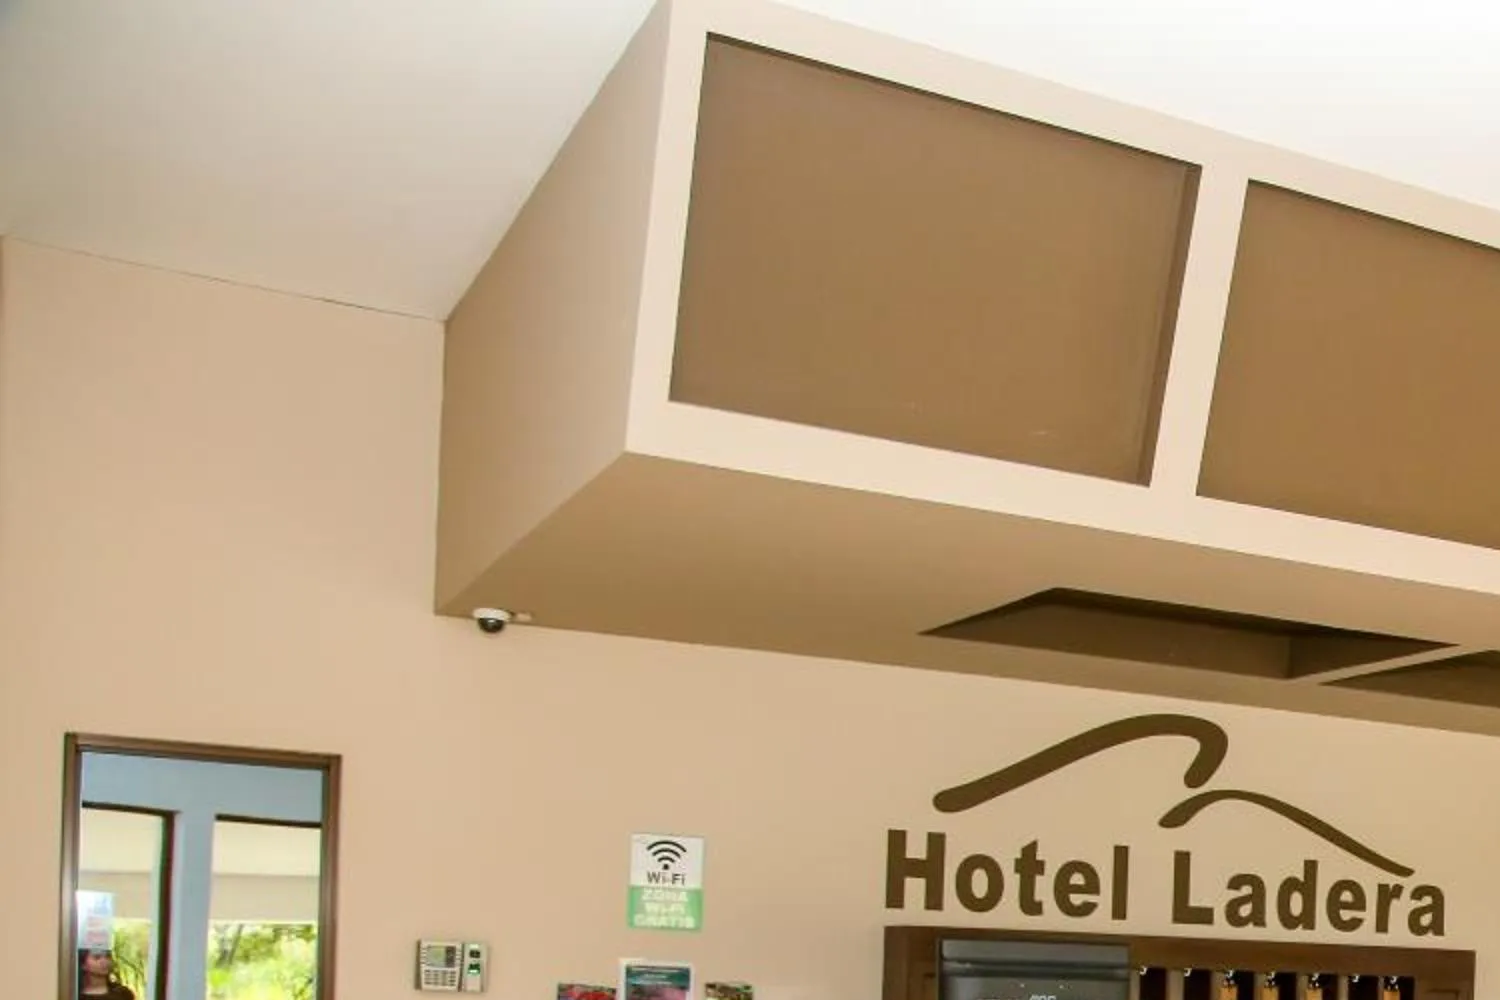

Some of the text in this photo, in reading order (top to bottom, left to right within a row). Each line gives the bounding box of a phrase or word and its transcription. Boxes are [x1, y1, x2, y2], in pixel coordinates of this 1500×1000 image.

[646, 870, 686, 886] Wi-Fi
[885, 829, 1445, 936] Hotel Ladera
